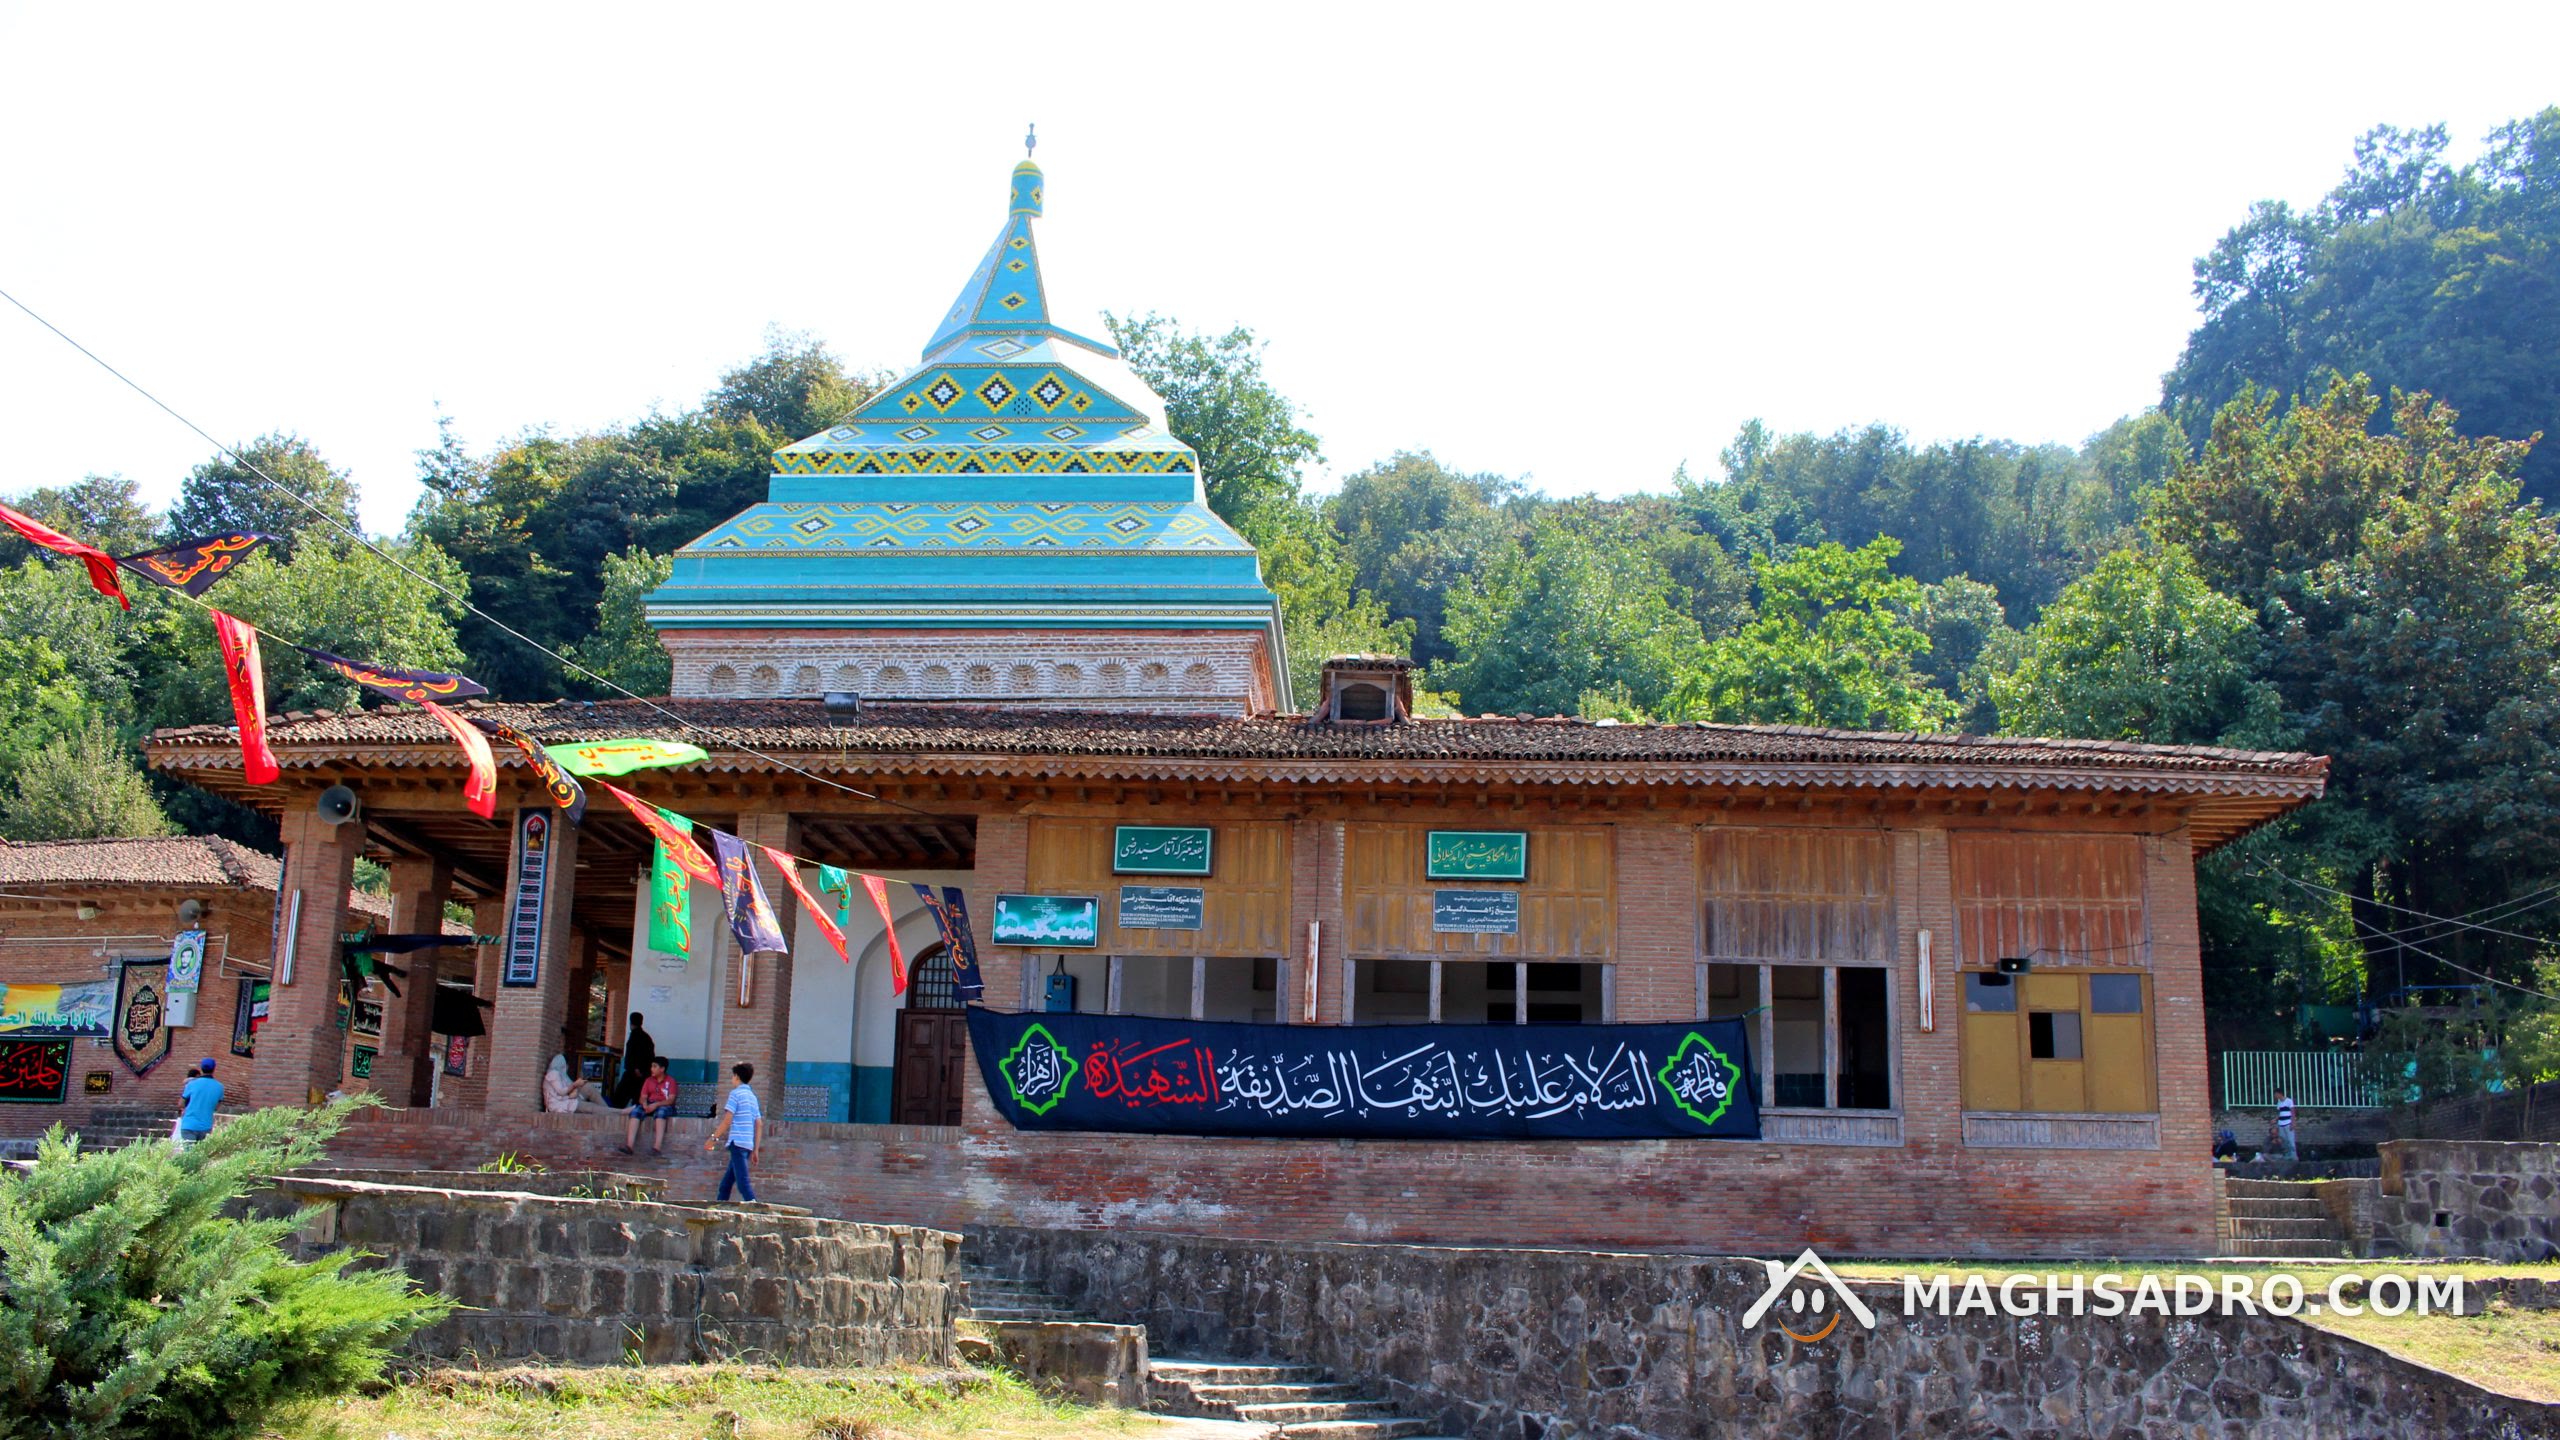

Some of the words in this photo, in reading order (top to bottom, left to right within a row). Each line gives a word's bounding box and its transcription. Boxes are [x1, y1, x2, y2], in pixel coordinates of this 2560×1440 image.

[1120, 837, 1137, 857] رضی
[1164, 836, 1180, 855] آقا
[1486, 844, 1520, 862] آرامگاه
[1465, 842, 1495, 870] شیخ
